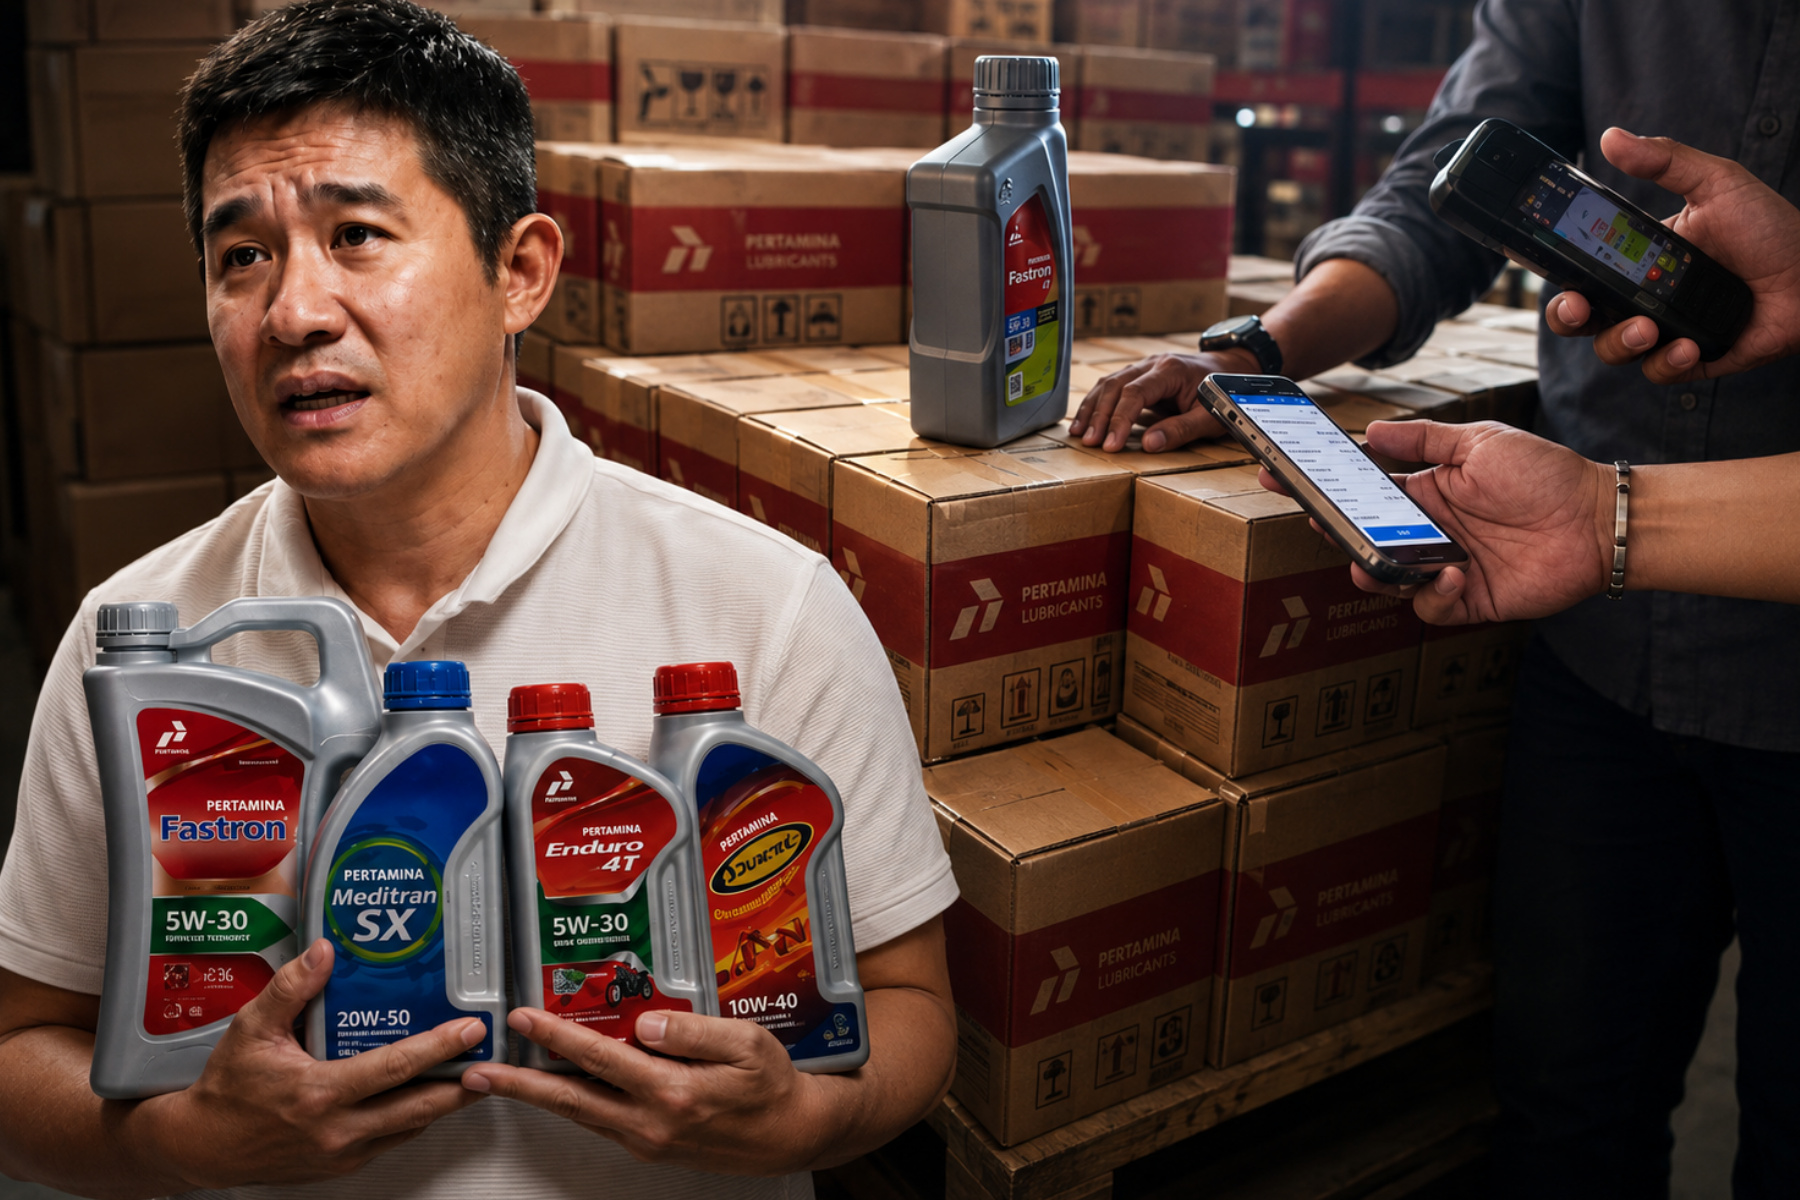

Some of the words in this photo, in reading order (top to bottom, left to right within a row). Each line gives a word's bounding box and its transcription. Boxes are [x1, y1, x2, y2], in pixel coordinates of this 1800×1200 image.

[745, 233, 840, 250] PERTAMINA
[746, 254, 837, 270] LUBRICANTS
[1008, 265, 1052, 286] Fastron
[1022, 571, 1107, 602] PERTAMINA
[1022, 595, 1103, 624] LUBRICANTS
[1326, 614, 1399, 641] LUBRICANTS
[206, 799, 286, 812] PERTAMINA
[160, 815, 287, 841] Fastron
[582, 824, 642, 837] PERTAMINA
[719, 811, 779, 852] PERTAMINA
[545, 839, 644, 858] Enduro
[601, 854, 641, 872] 4T
[343, 868, 425, 882] PERTAMINA
[331, 886, 437, 906] Meditran
[1317, 868, 1398, 907] PERTAMINA
[165, 910, 249, 932] 5W-30
[1316, 891, 1393, 928] LUBRICANTS
[352, 908, 417, 942] SX
[553, 913, 629, 936] 5W-30
[1098, 927, 1181, 969] PERTAMINA
[1098, 950, 1177, 990] LUBRICANTS
[728, 992, 798, 1016] 10W-40
[337, 1009, 411, 1028] 20W-50
